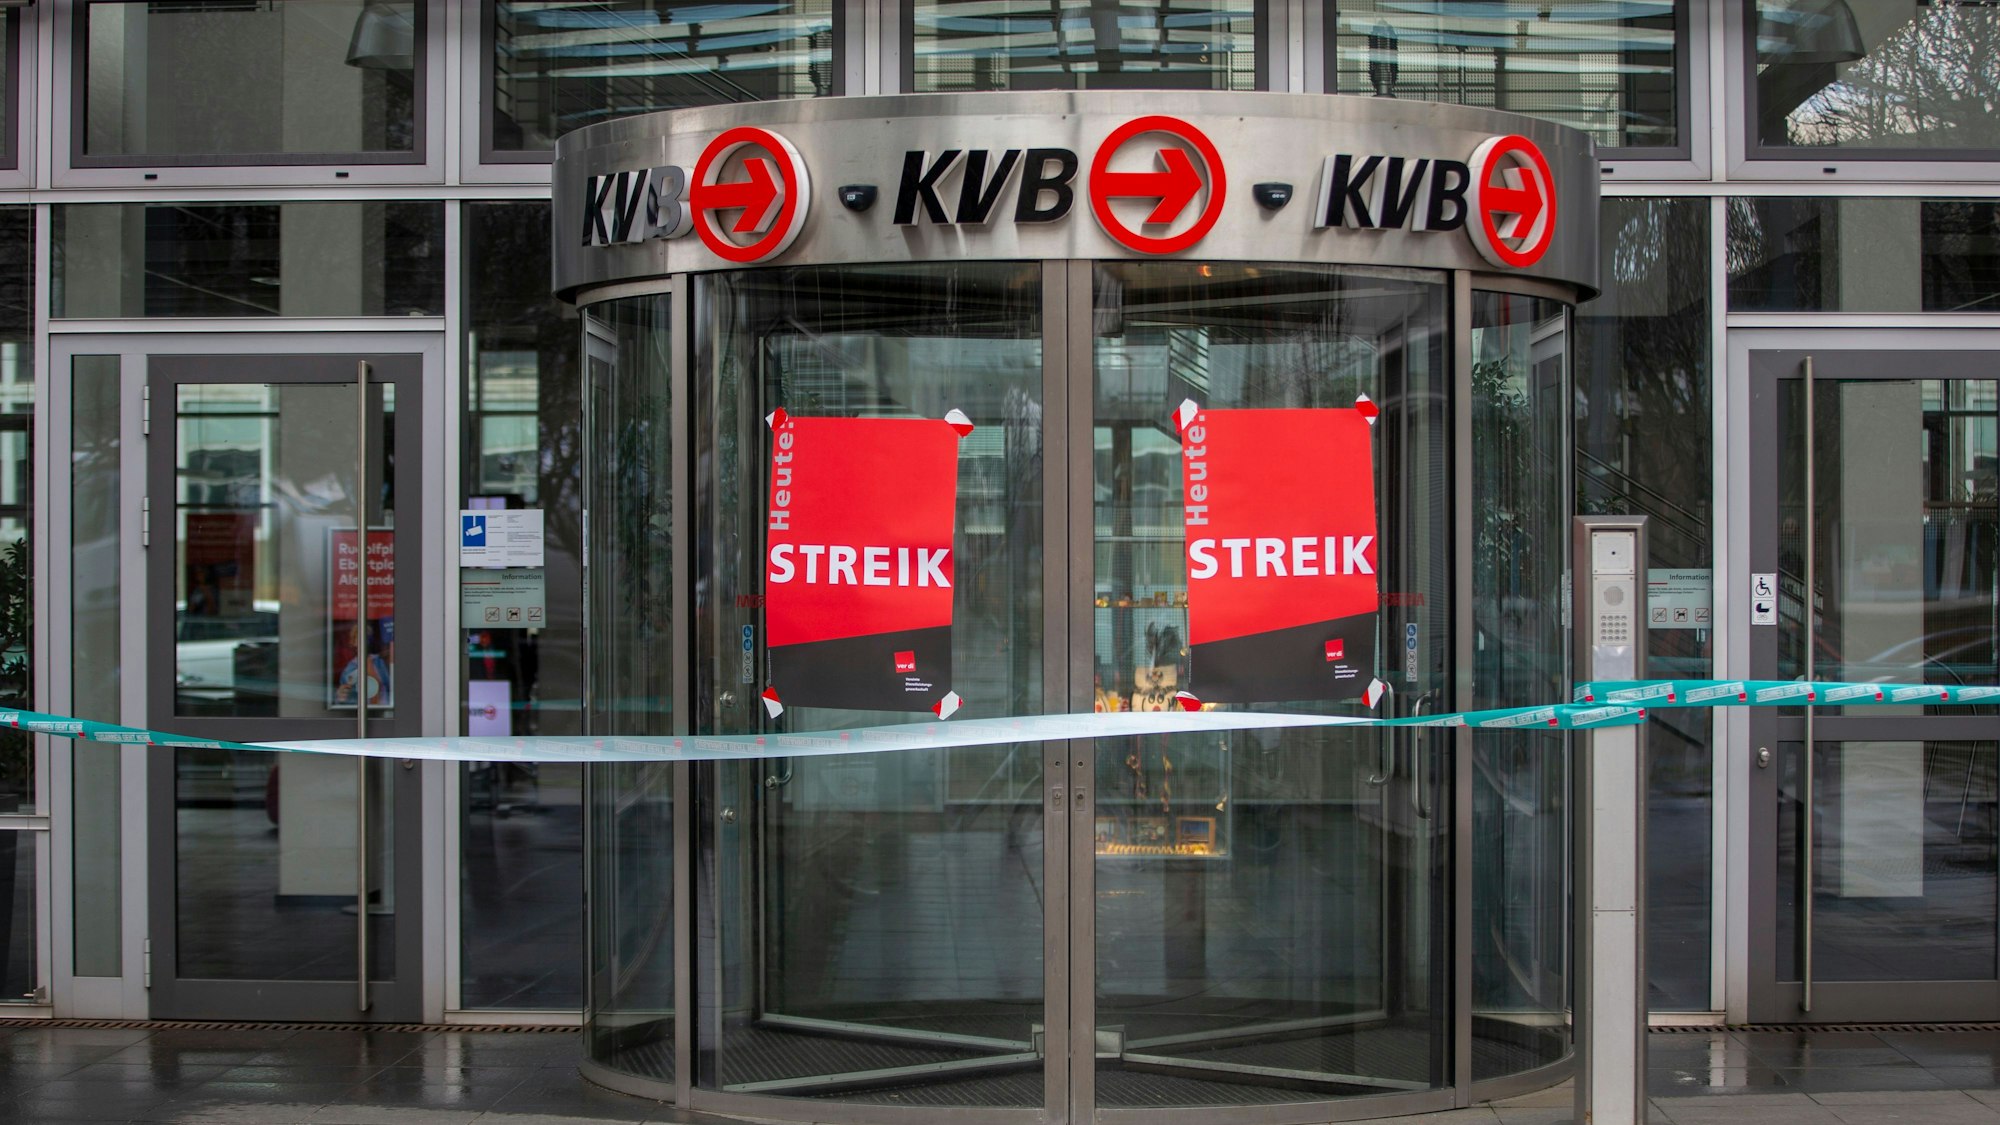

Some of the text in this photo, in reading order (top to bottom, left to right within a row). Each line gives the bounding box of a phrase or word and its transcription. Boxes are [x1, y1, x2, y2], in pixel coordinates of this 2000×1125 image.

[582, 165, 686, 246] KVB
[893, 148, 1079, 224] KVB
[1316, 154, 1471, 231] KVB
[769, 543, 952, 588] STREIK
[1188, 535, 1375, 580] STREIK
